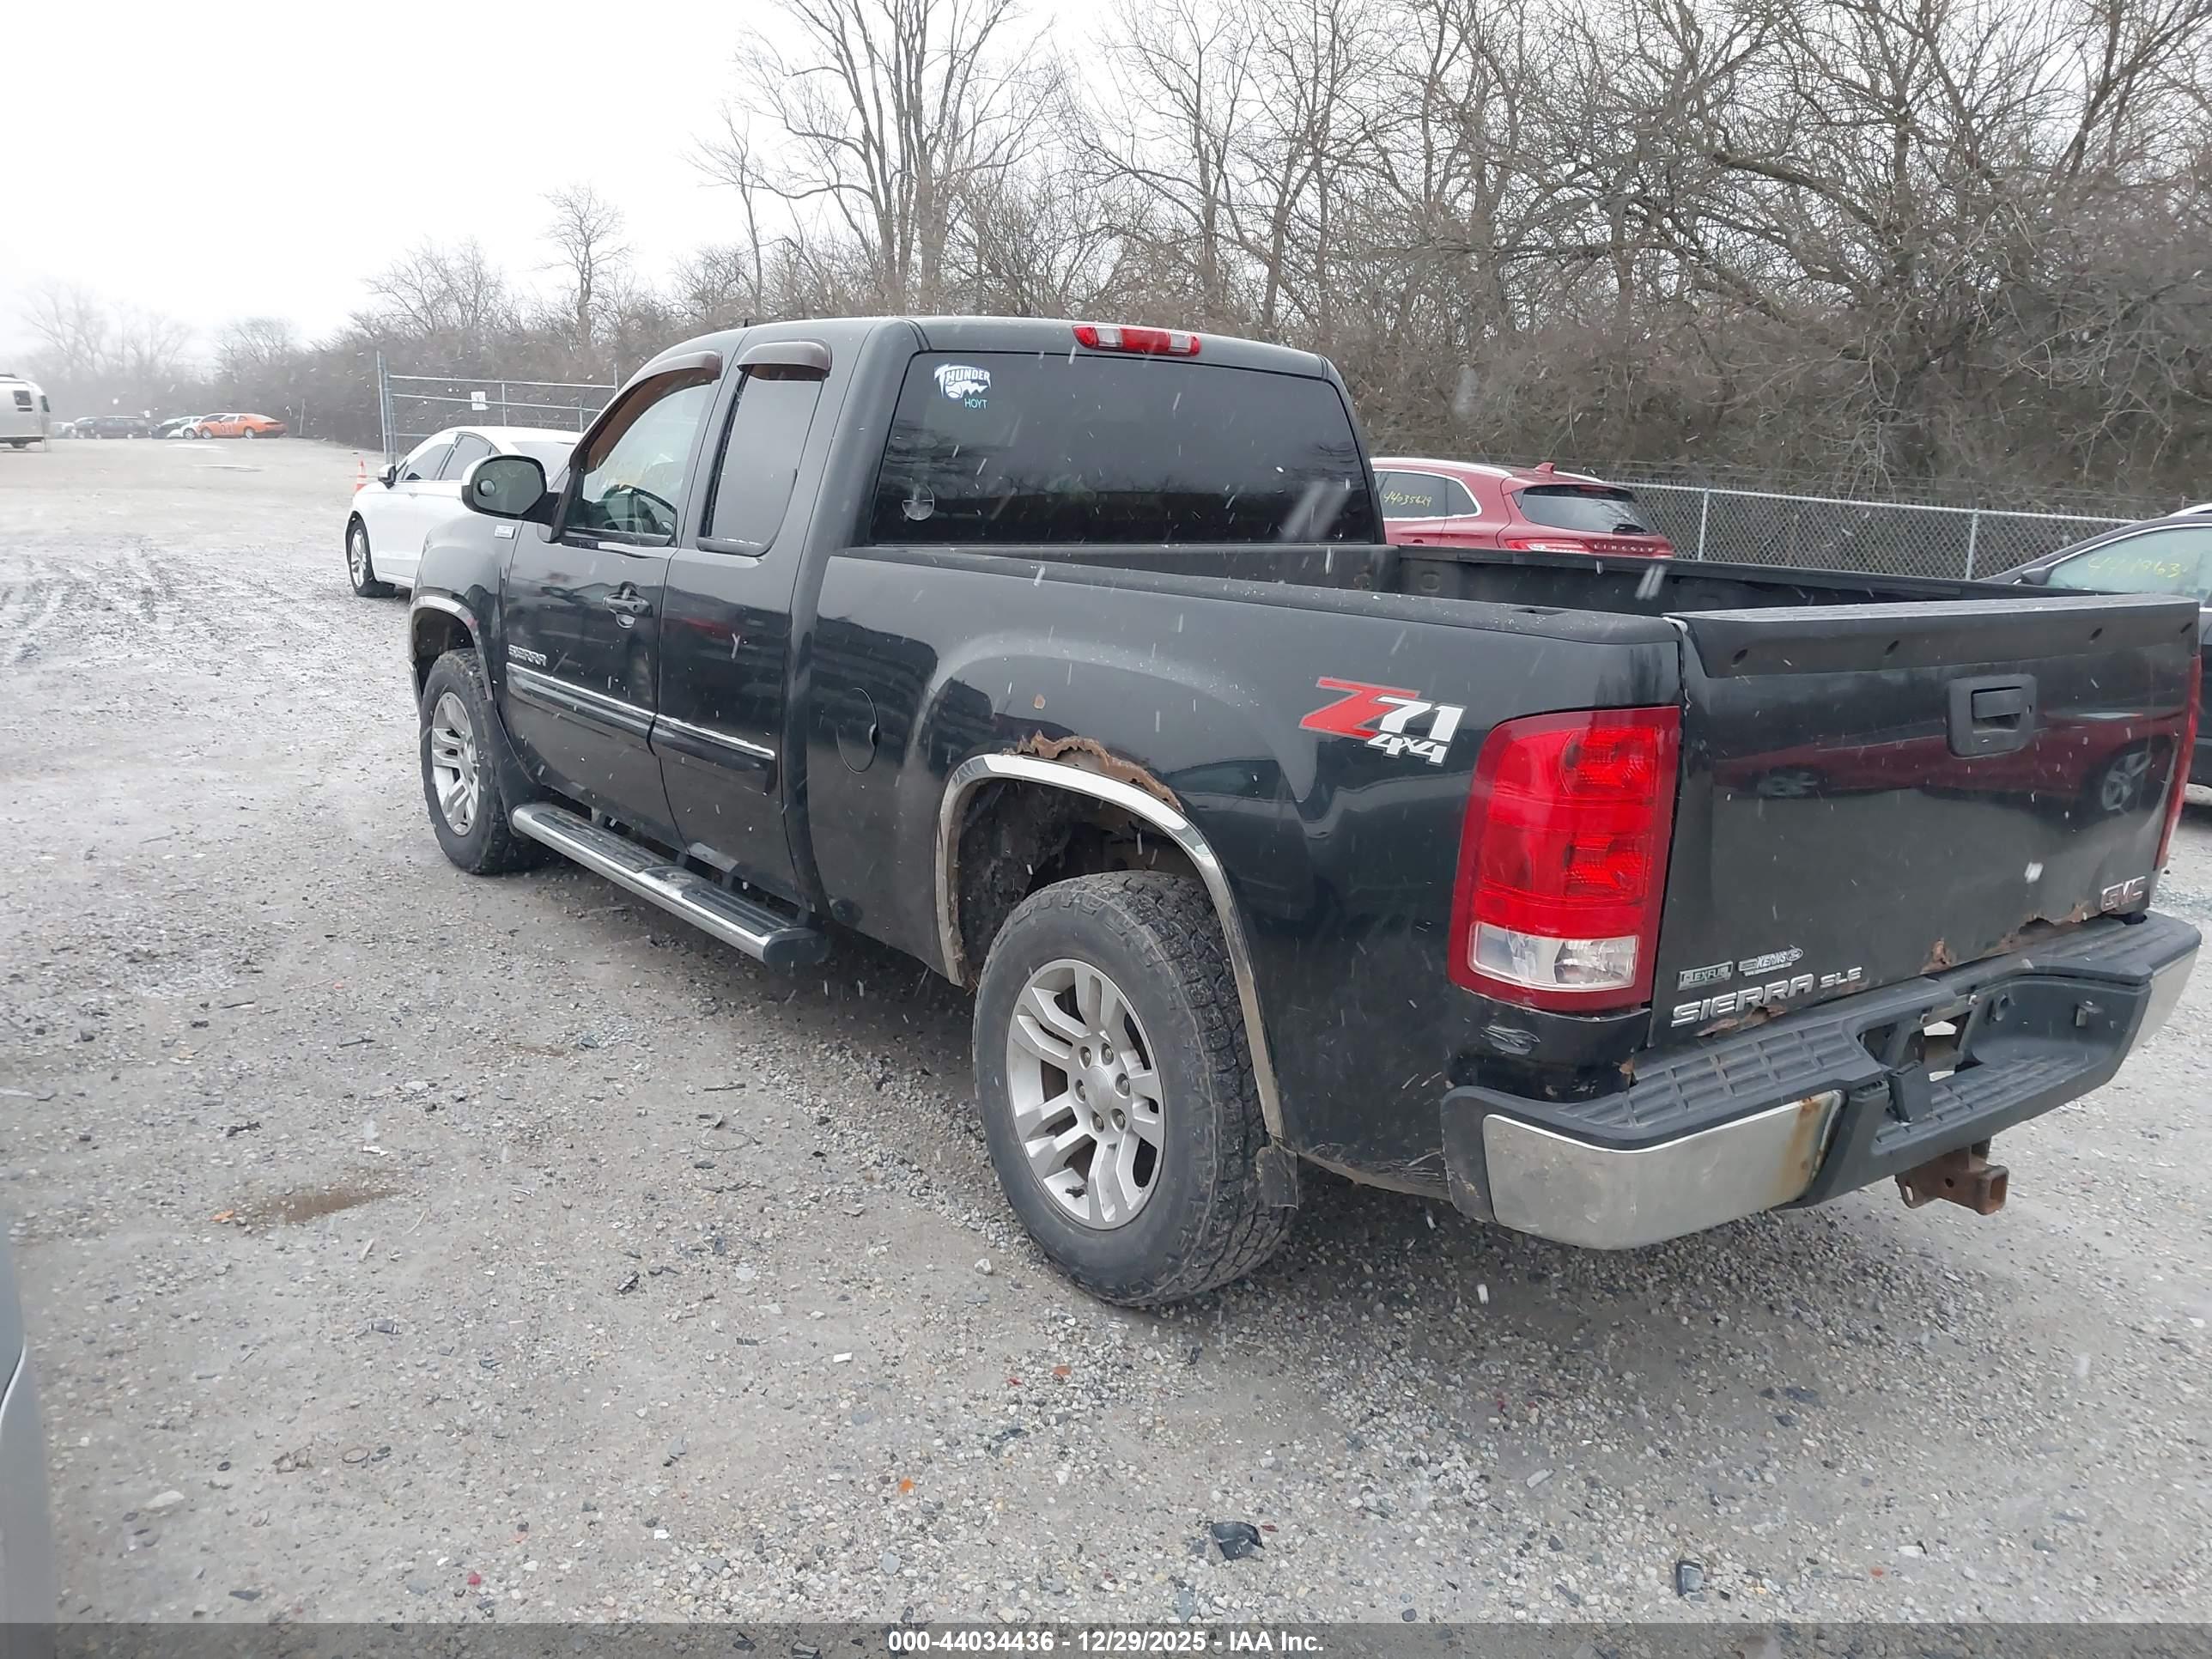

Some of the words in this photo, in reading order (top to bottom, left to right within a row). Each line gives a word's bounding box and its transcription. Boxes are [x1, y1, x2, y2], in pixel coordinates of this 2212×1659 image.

[934, 363, 991, 398] THUNDER
[964, 398, 988, 409] HOYT
[1298, 676, 1467, 744] Z71
[2101, 875, 2146, 912] GMC
[1670, 973, 1814, 1028] SIERRA
[1819, 967, 1863, 989] SLE
